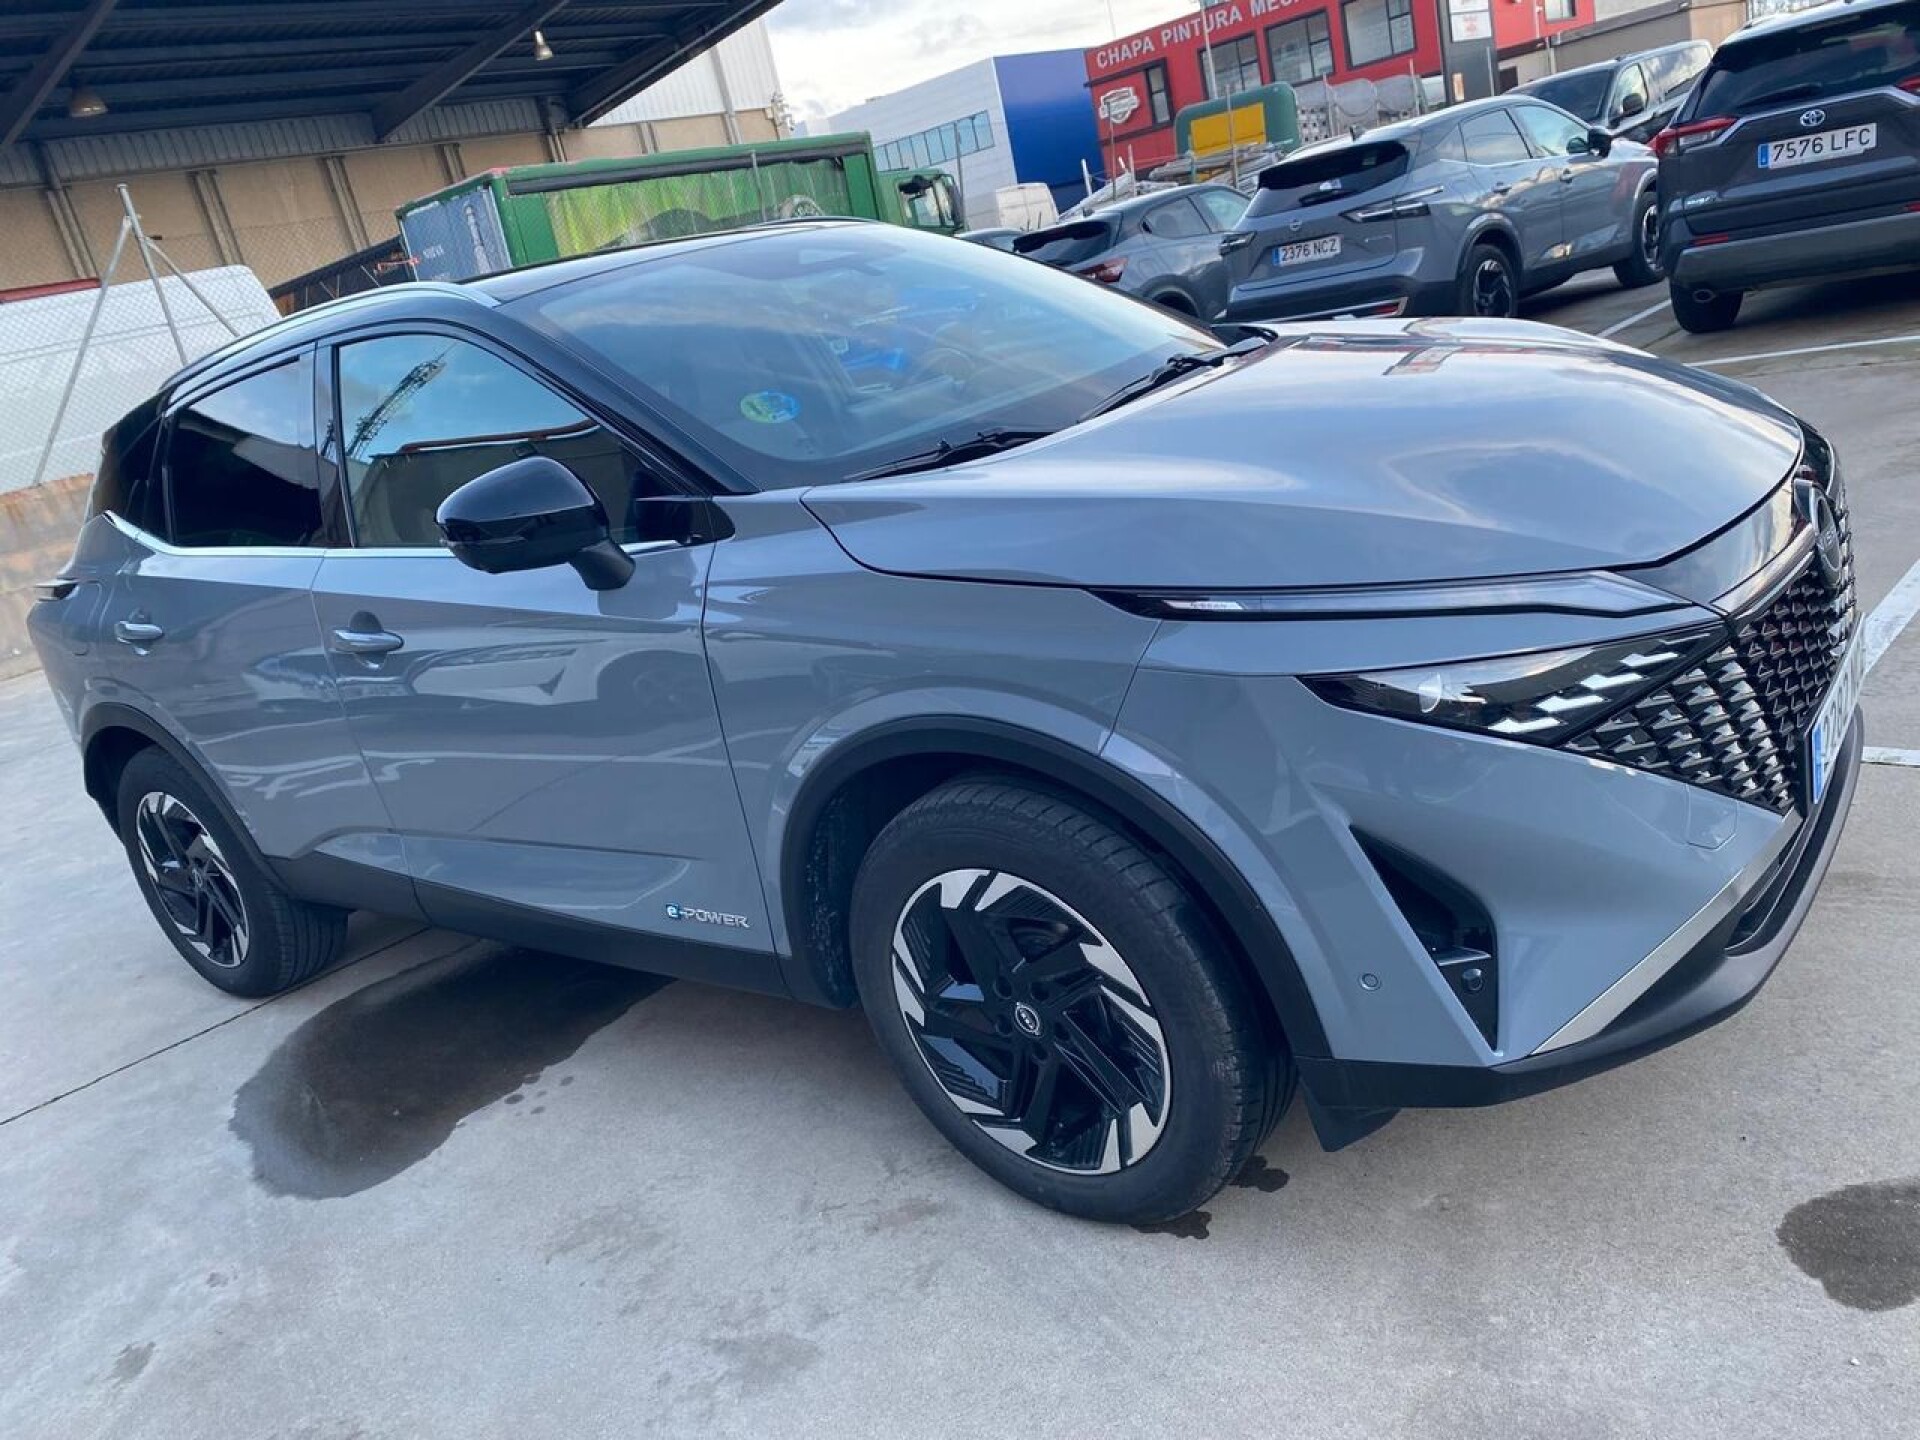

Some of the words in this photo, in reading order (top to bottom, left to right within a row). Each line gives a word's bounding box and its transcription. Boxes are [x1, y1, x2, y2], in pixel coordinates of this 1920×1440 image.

[1097, 36, 1155, 69] CHAPA
[1161, 6, 1242, 48] PINTURA
[1773, 137, 1824, 162] 7576
[1831, 128, 1871, 151] LFC
[1282, 243, 1310, 261] 2376
[1313, 238, 1337, 254] NCZ
